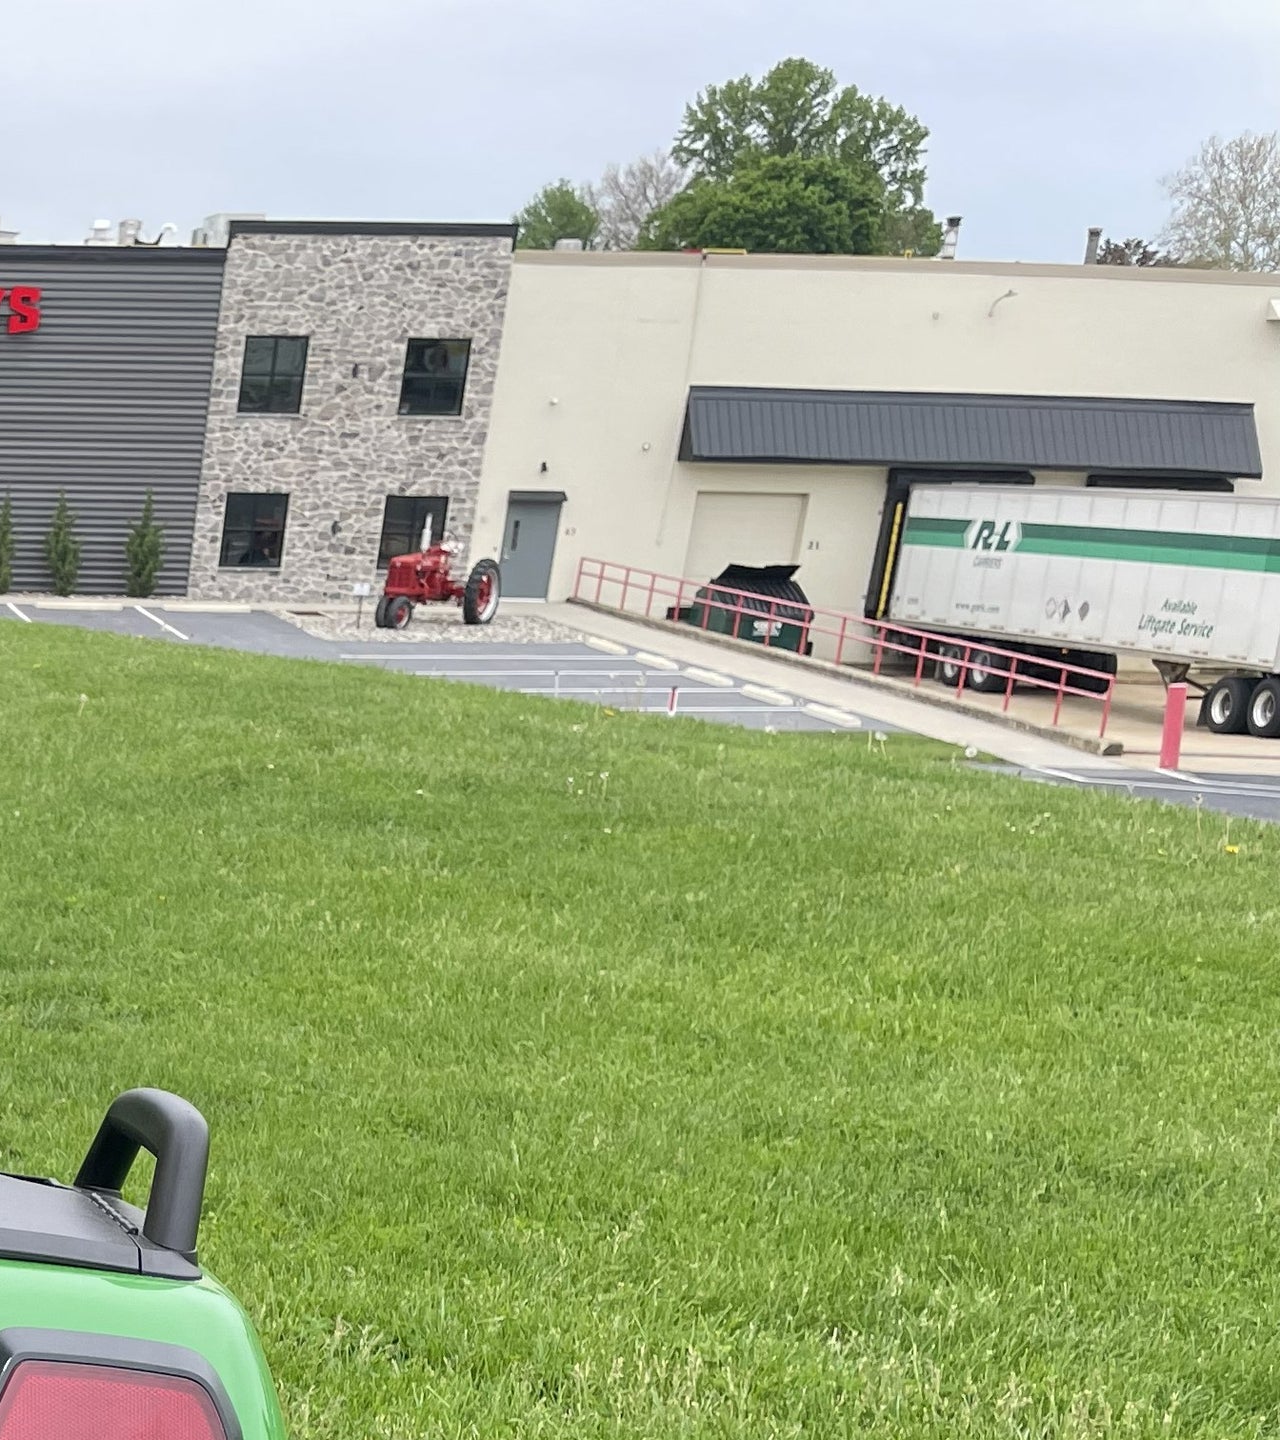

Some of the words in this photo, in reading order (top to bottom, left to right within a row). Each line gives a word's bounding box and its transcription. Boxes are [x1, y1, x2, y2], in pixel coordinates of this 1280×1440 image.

[1161, 598, 1198, 615] Available
[1138, 613, 1176, 637] Liftgate
[1177, 618, 1214, 639] Service
